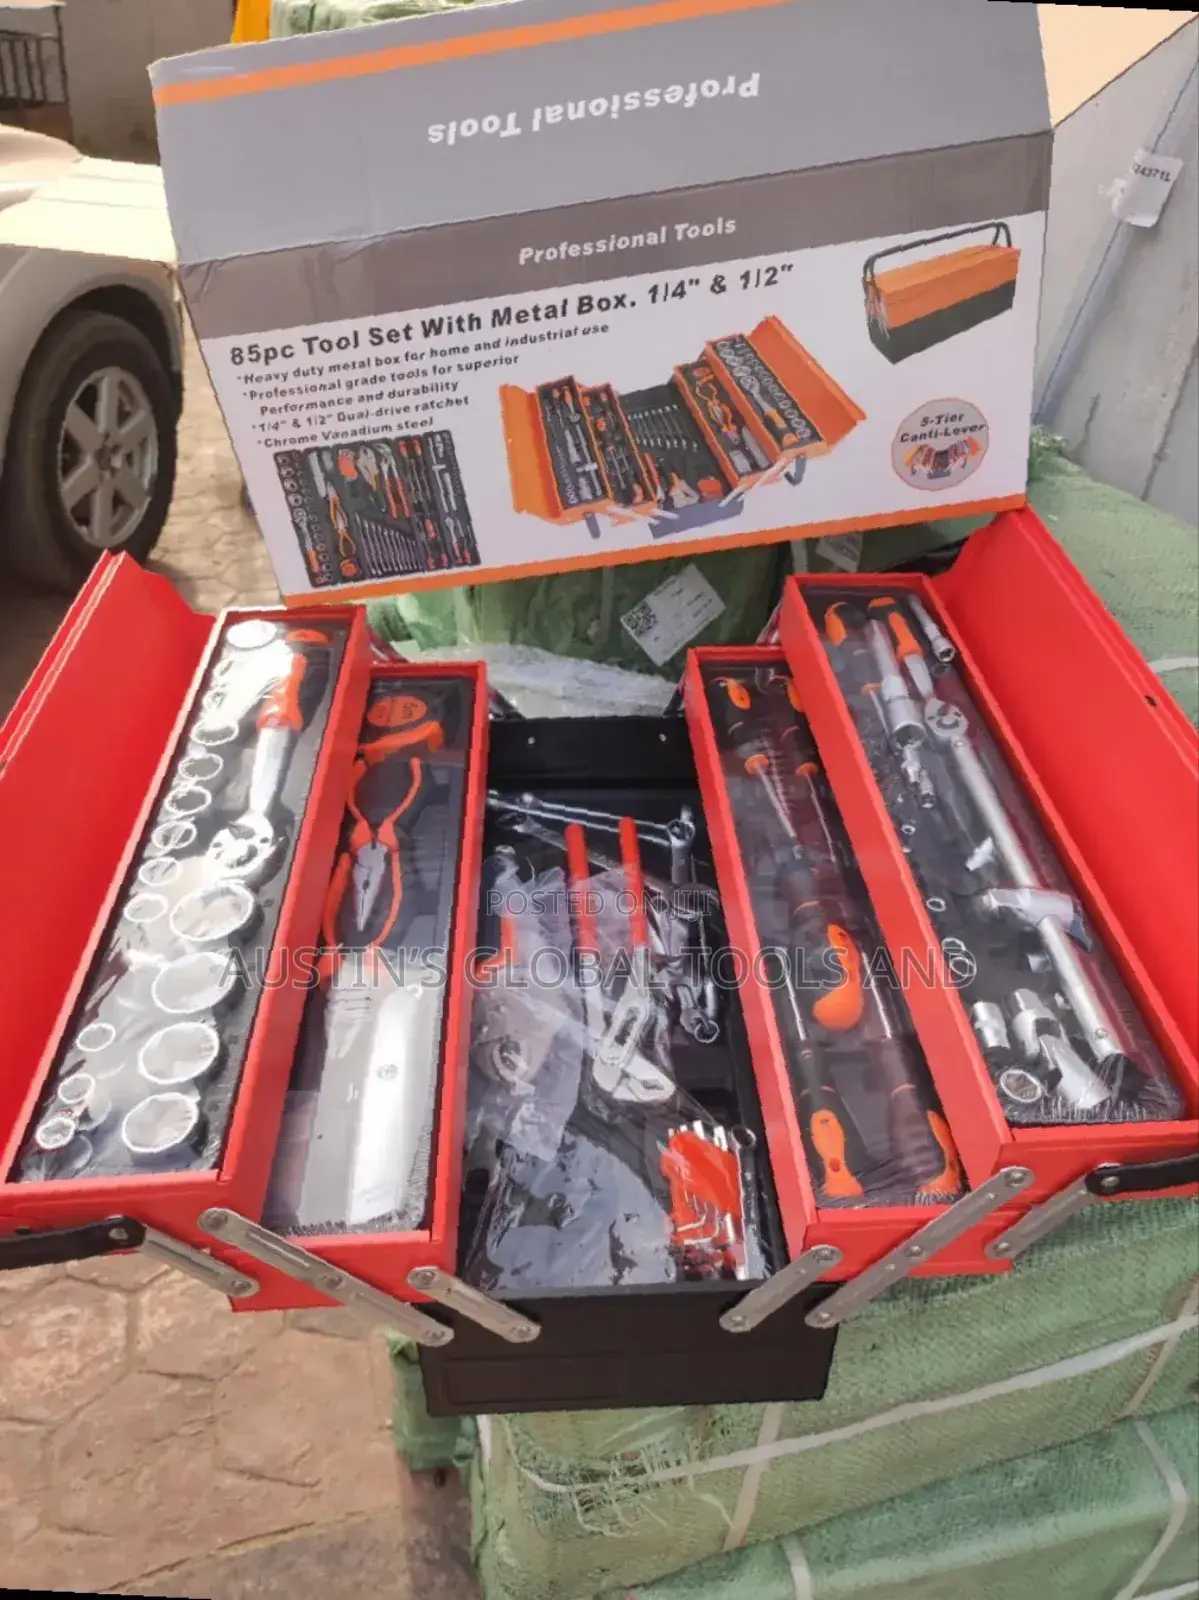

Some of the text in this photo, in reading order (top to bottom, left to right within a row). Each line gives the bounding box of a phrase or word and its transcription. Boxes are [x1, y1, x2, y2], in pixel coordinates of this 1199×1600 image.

[428, 72, 760, 145] Professional Tools
[518, 217, 737, 266] Professional Tools
[230, 264, 794, 366] 85pc Tool Set With Metal Box. 1/4" & 1/2"
[292, 364, 324, 378] duty
[328, 357, 371, 374] metal
[374, 354, 400, 367] box
[404, 351, 426, 362] for
[429, 343, 469, 358] home
[474, 338, 500, 352] and
[505, 327, 578, 347] industrial
[582, 324, 609, 335] use
[345, 375, 386, 390] grade
[390, 368, 428, 382] tools
[432, 364, 452, 376] for
[457, 353, 519, 372] superior
[260, 380, 459, 416] Performance and durability
[292, 418, 301, 429] &
[306, 413, 333, 426] 1/2"
[337, 404, 411, 422] Dual-drive
[414, 396, 469, 412] ratchet
[321, 421, 392, 440] Vanadium
[396, 417, 433, 431] steel
[900, 423, 986, 443] Canti-Lever
[920, 412, 964, 427] 5-Tier
